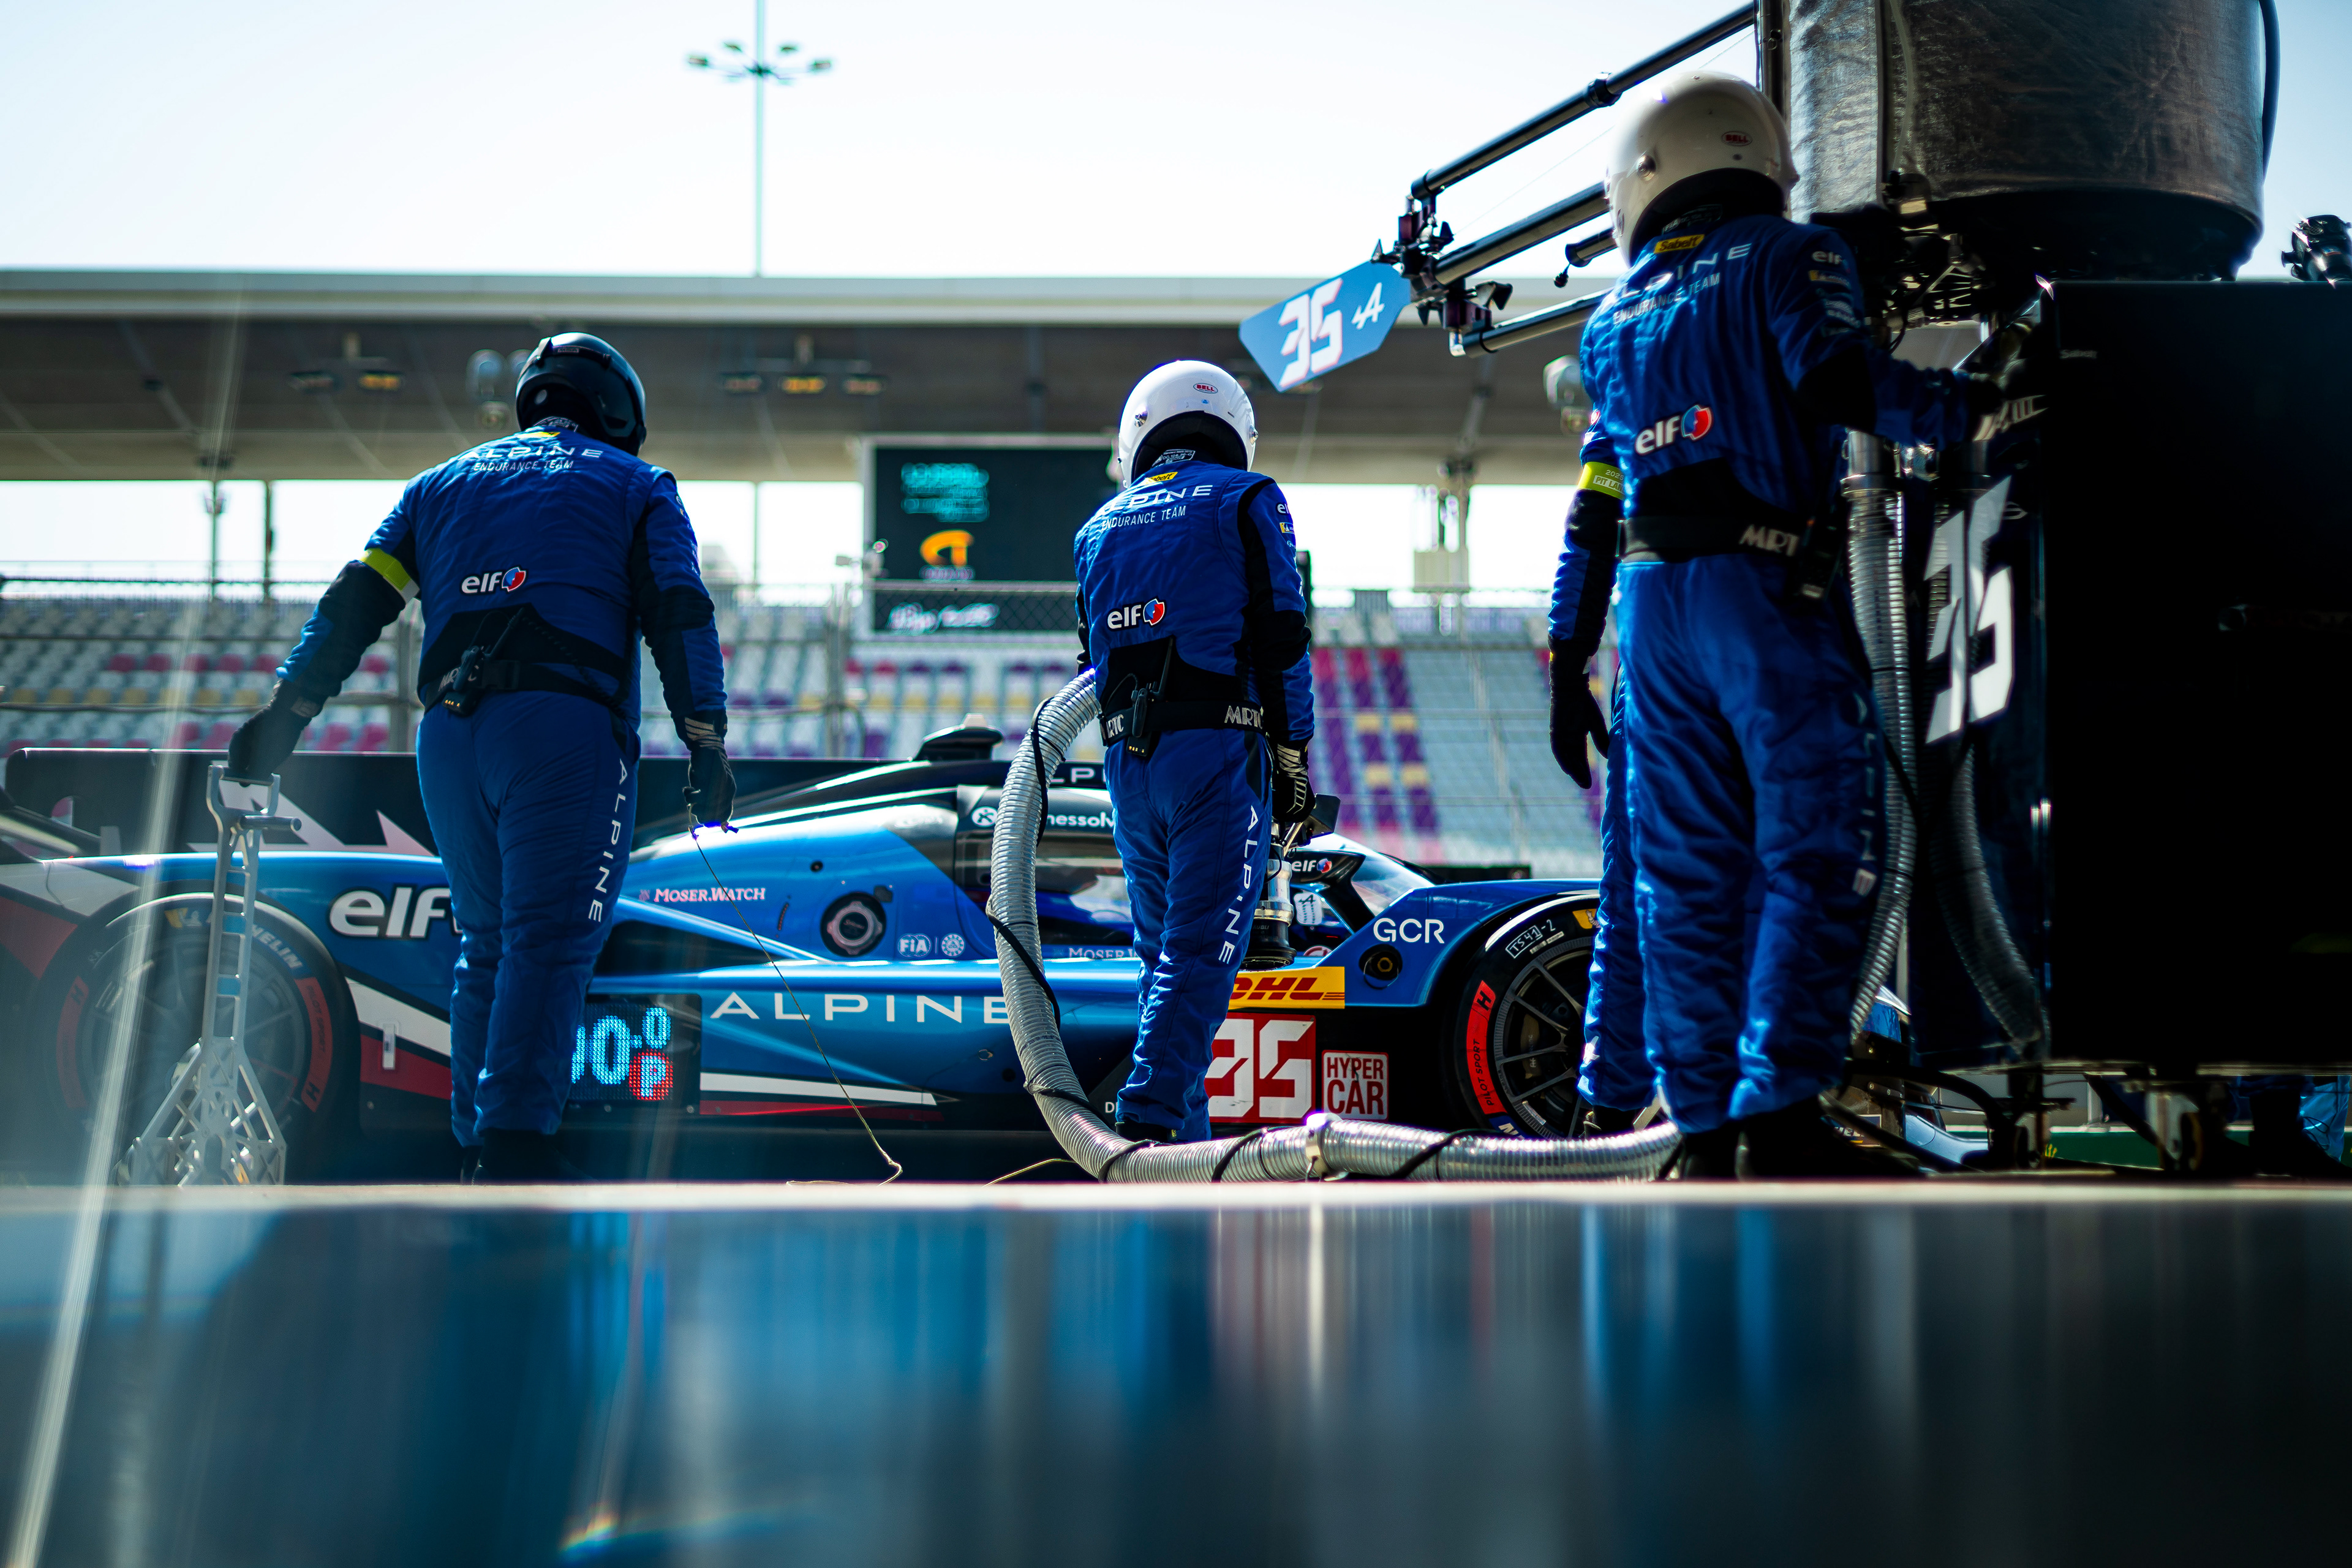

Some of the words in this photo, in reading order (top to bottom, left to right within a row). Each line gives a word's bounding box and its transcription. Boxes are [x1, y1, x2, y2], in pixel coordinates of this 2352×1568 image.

[1689, 273, 1721, 295] TEAM
[1278, 277, 1343, 387] 35
[1635, 415, 1680, 455] elf
[473, 461, 539, 472] ENDURANCE
[544, 460, 574, 470] TEAM
[1605, 469, 1624, 480] 2025
[1595, 477, 1608, 485] PIT
[1101, 511, 1156, 531] ENDURANCE
[1161, 505, 1186, 521] TEAM
[461, 571, 502, 594] elf
[1107, 605, 1142, 630] elf
[1923, 475, 2012, 744] 35
[588, 758, 627, 922] ALPINE
[1292, 860, 1316, 872] elf
[330, 887, 451, 938] elf
[1373, 918, 1445, 944] GCR
[1230, 978, 1327, 1000] DHL
[1477, 990, 1492, 1011] H
[710, 992, 1009, 1024] ALPINE
[1205, 1019, 1314, 1118] 35
[1327, 1057, 1384, 1080] HYPER
[1472, 1039, 1484, 1075] SPORT
[641, 1055, 666, 1097] P
[1327, 1080, 1384, 1115] CAR
[1479, 1076, 1494, 1106] PILOT
